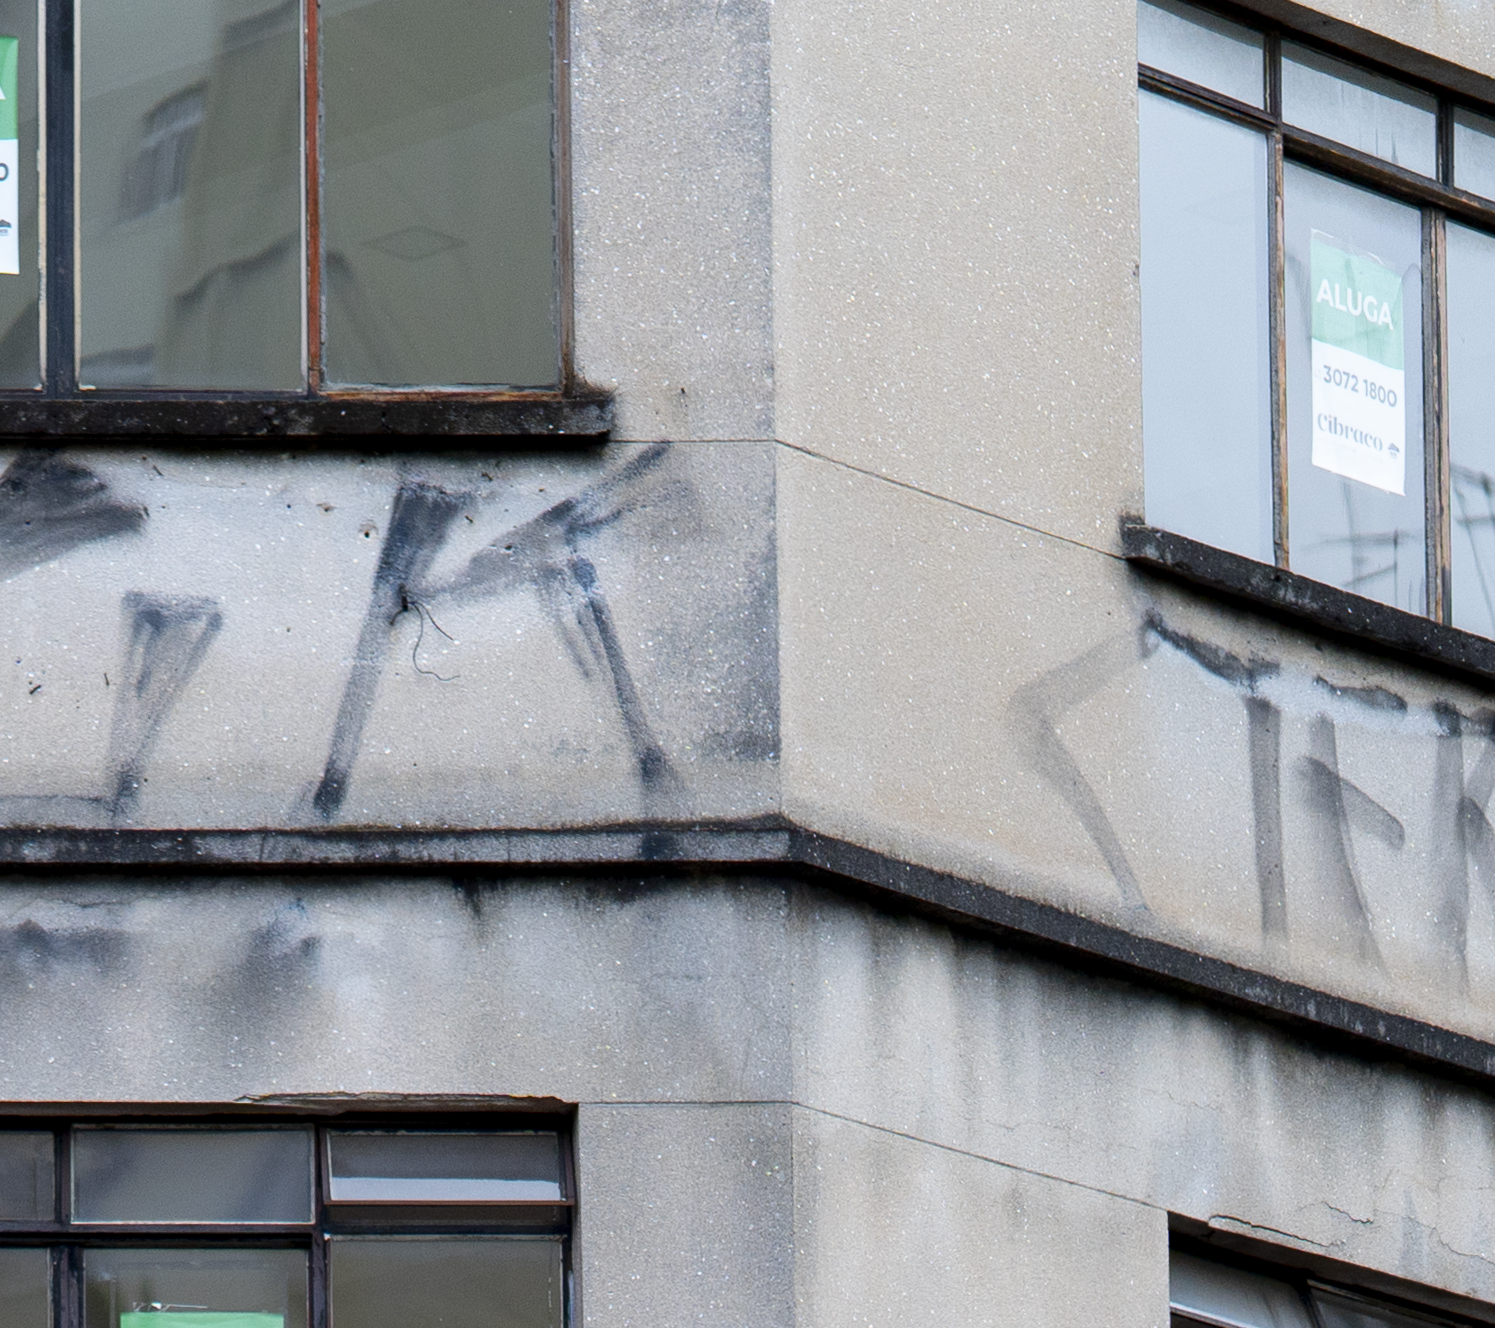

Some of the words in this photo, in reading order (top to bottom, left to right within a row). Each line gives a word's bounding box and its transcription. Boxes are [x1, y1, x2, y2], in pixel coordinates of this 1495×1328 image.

[1315, 279, 1394, 331] ALUGA
[1323, 364, 1359, 394] 3072
[1363, 379, 1398, 408] 1800
[1317, 412, 1383, 452] Cibraco
